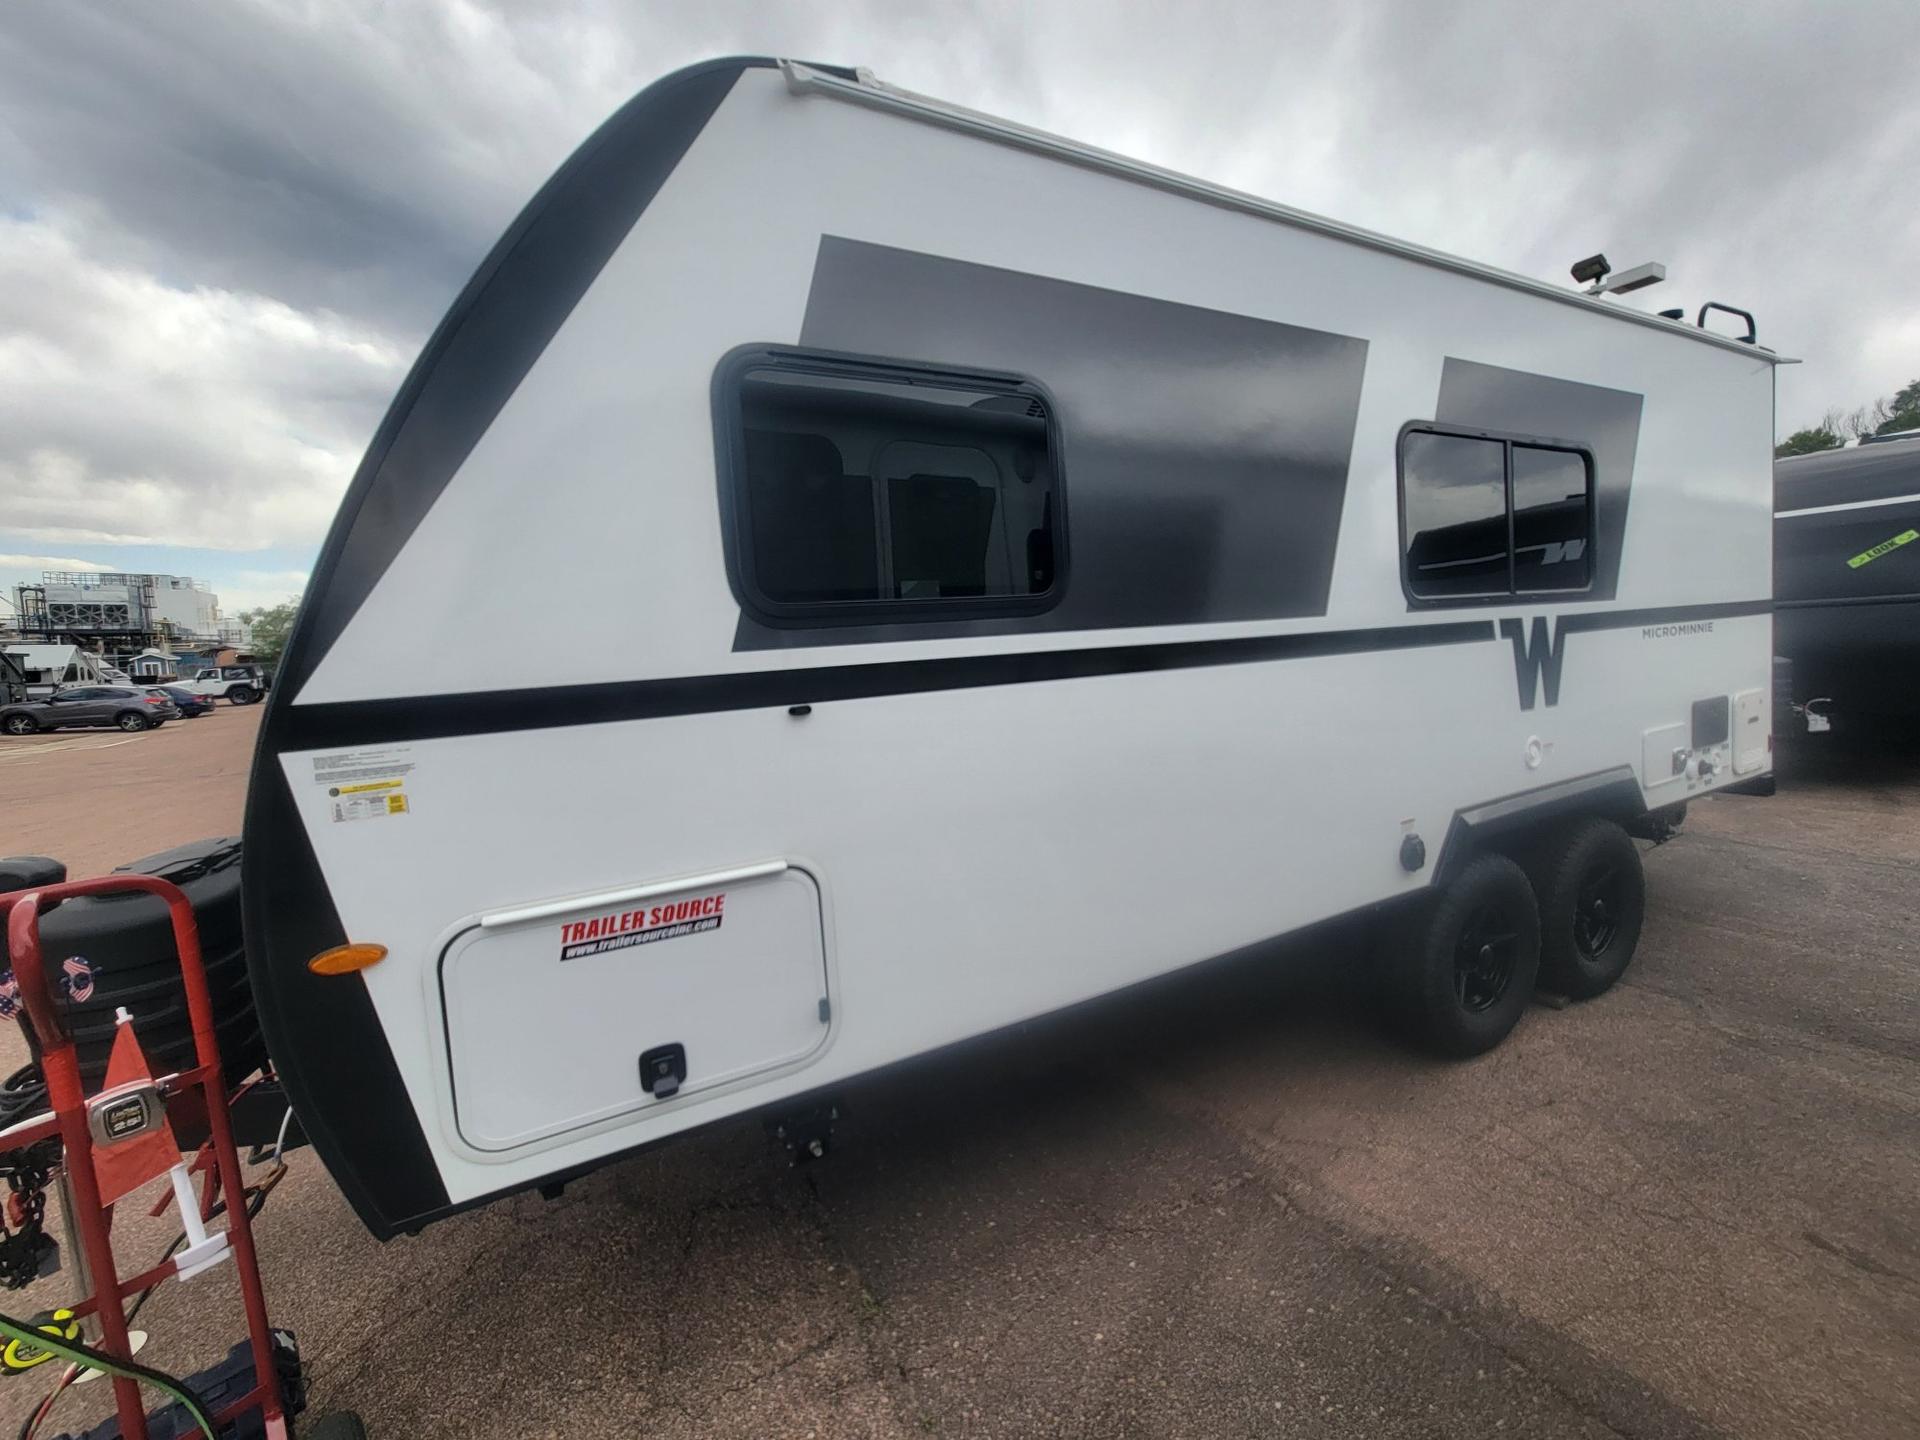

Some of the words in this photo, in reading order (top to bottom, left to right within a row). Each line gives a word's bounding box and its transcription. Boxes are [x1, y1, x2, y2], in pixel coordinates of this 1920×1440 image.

[1866, 540, 1897, 558] LOOK
[1642, 622, 1714, 639] MICROMINNIE
[1500, 616, 1566, 711] W
[561, 910, 645, 943] TRAILER
[650, 894, 726, 925] SOURCE
[565, 917, 719, 958] www.trailersourceinc.com
